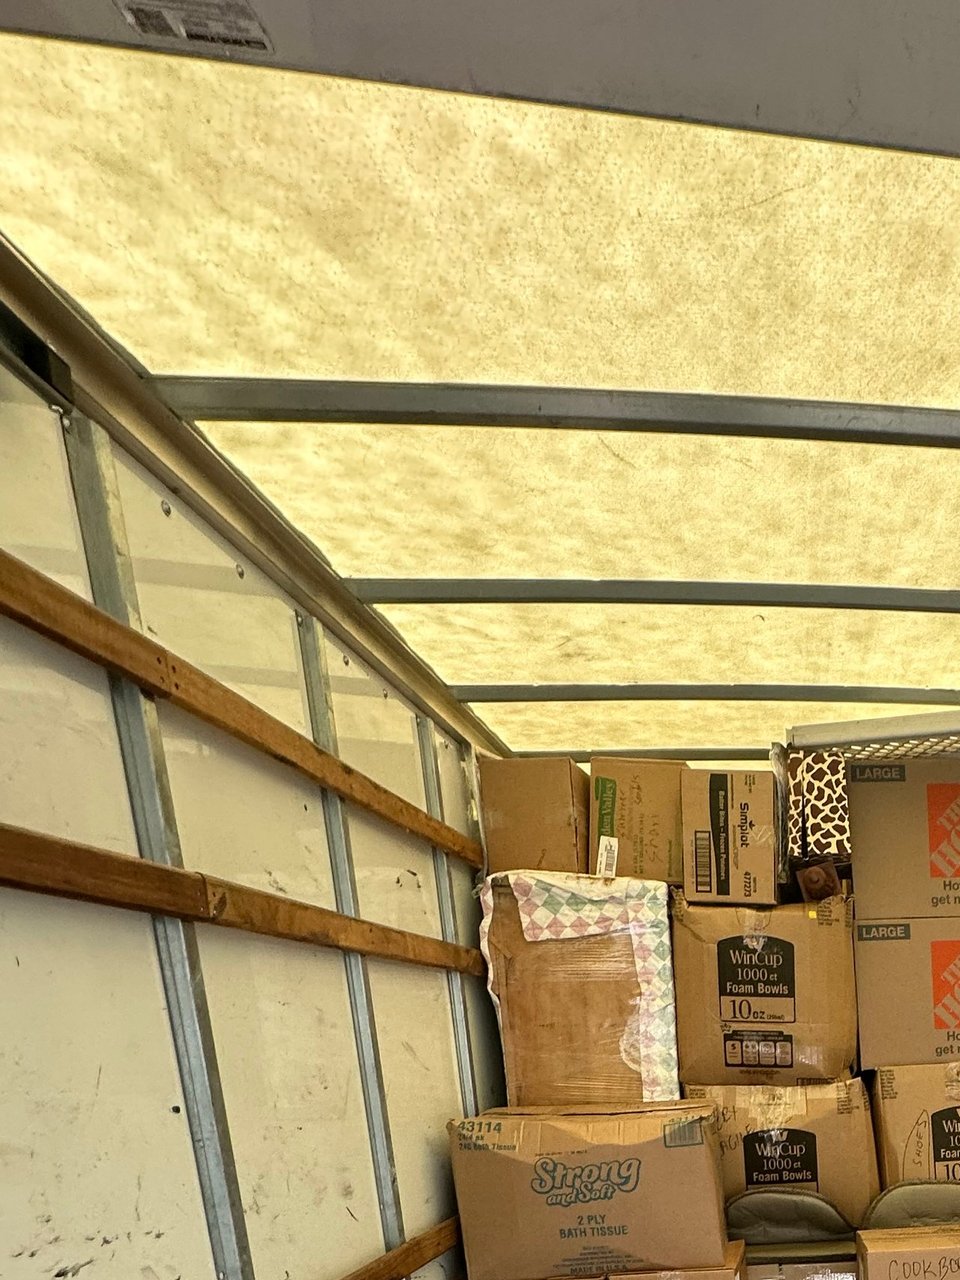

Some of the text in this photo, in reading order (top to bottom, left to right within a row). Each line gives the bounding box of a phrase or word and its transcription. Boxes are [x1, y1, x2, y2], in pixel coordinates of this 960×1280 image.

[856, 767, 900, 779] LARGE
[737, 802, 750, 848] Simplot
[931, 895, 952, 908] get
[862, 926, 906, 938] LARGE
[730, 949, 783, 968] WinCup
[737, 968, 778, 981] 1000 ct
[726, 982, 789, 994] Foam Bowls
[729, 999, 752, 1020] 10
[752, 1011, 765, 1020] oz
[935, 1044, 955, 1057] get
[458, 1121, 502, 1134] 43114
[755, 1142, 806, 1158] WinCup
[912, 1120, 927, 1168] SHOES
[763, 1158, 792, 1170] 1000
[531, 1157, 642, 1195] Strong
[753, 1169, 812, 1182] Foam Bowls
[546, 1181, 617, 1207] and Soft
[577, 1214, 606, 1225] 2 PLY
[559, 1225, 629, 1239] BATH TISSUE
